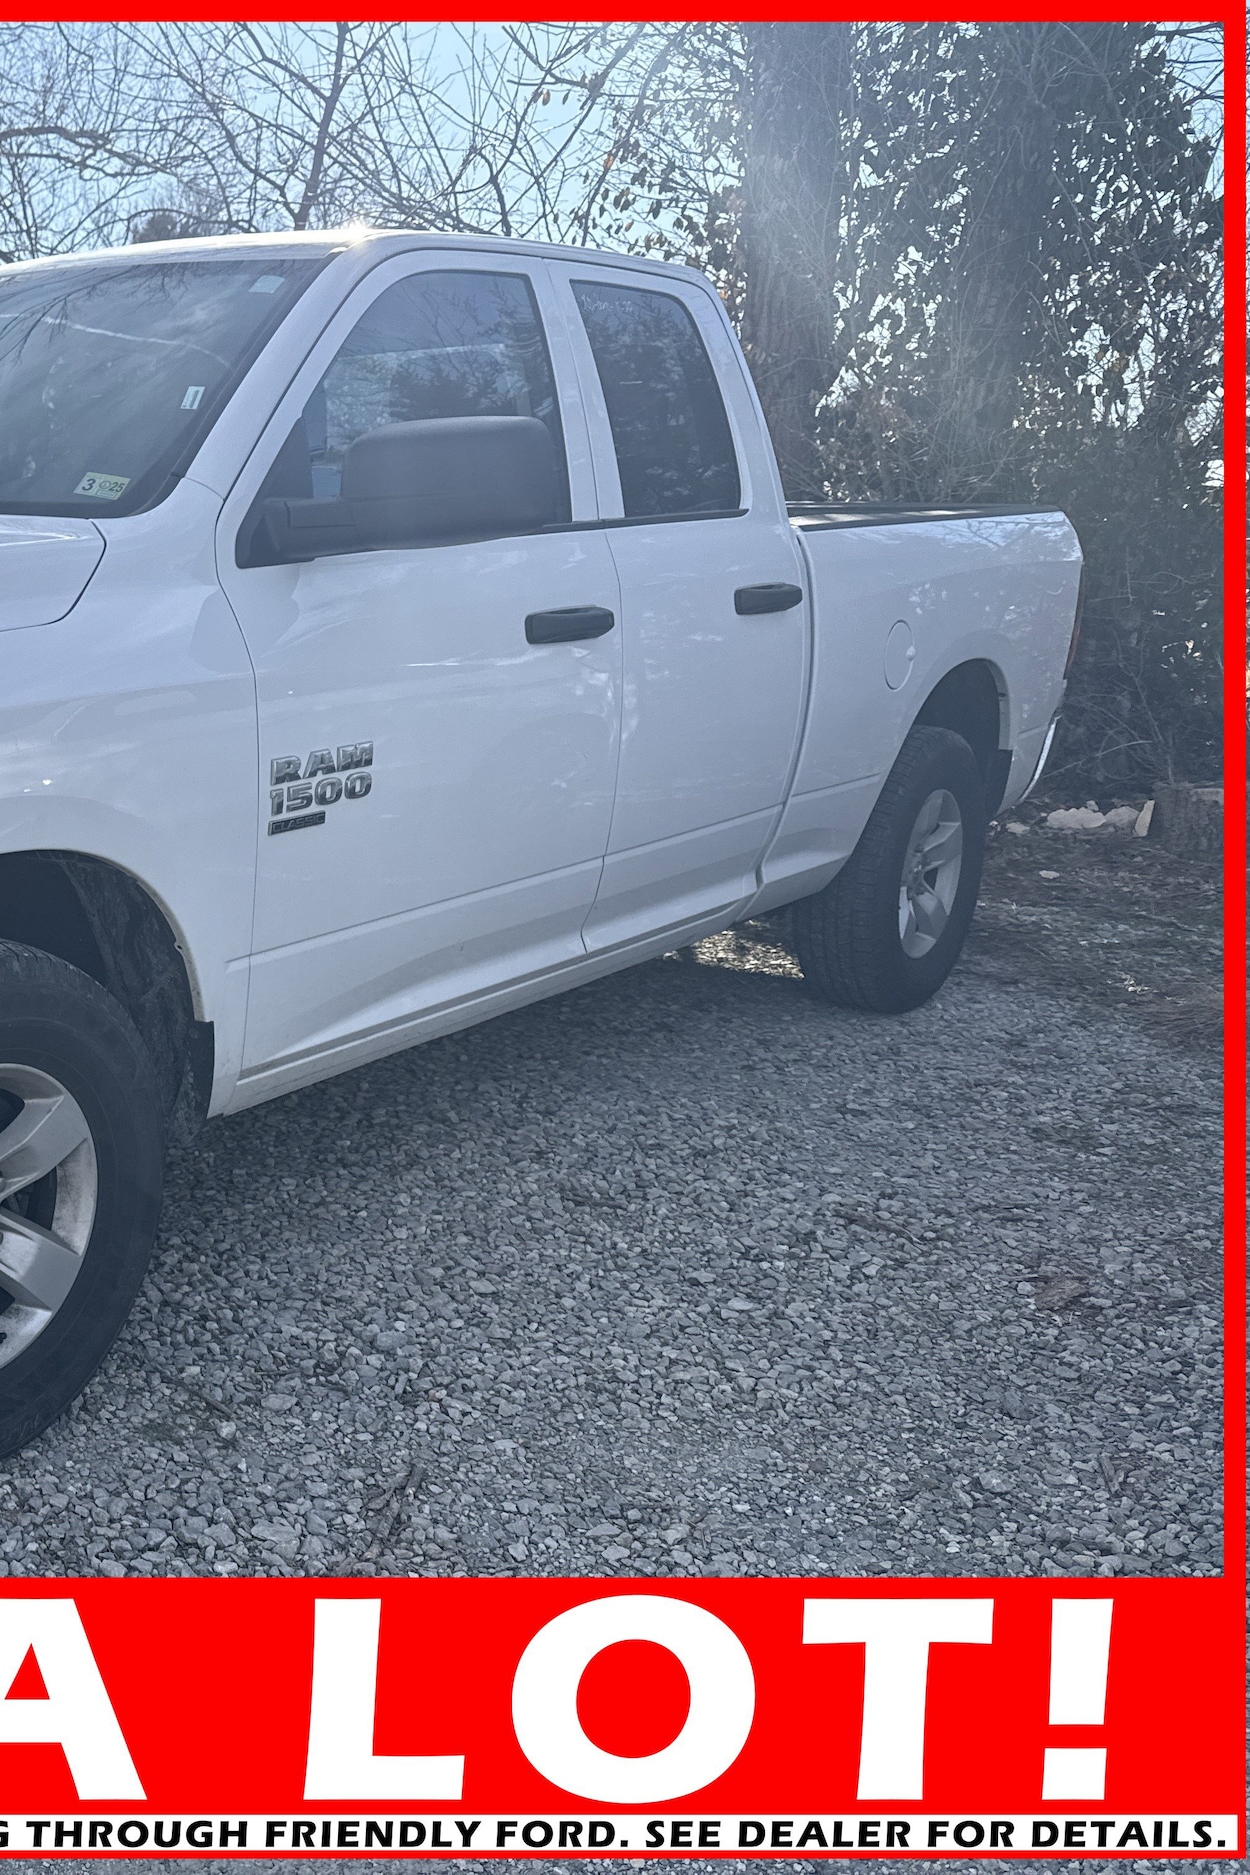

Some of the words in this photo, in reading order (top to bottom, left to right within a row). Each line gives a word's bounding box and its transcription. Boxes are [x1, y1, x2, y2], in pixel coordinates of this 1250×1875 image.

[81, 478, 96, 491] 3
[108, 481, 126, 493] 25
[270, 741, 374, 786] RAM
[269, 771, 373, 816] 1500
[269, 811, 325, 835] CLASSIC
